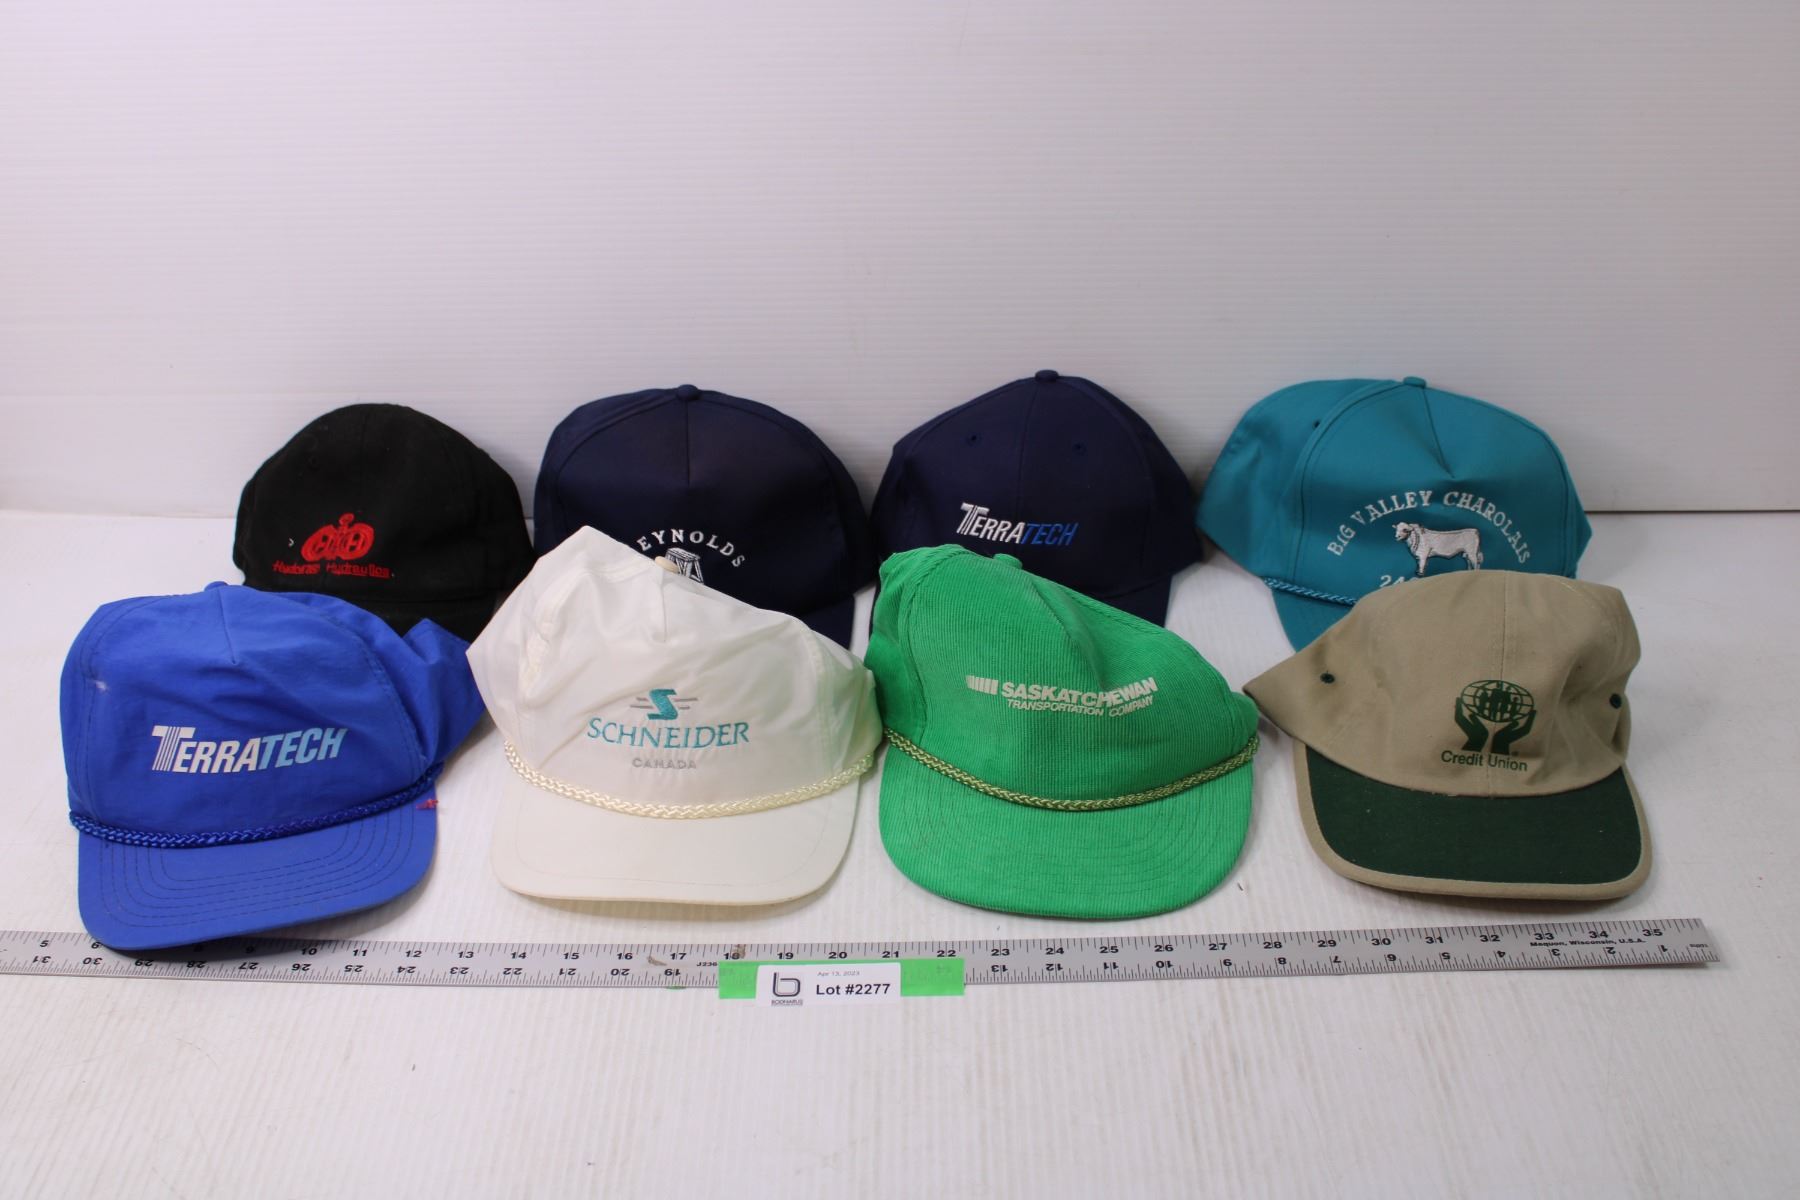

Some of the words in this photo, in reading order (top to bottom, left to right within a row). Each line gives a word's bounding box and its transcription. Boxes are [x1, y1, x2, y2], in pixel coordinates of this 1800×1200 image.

[956, 502, 1079, 546] TERRATECH
[1327, 524, 1356, 556] BIG
[1351, 490, 1433, 526] VALLEY
[1443, 491, 1531, 564] CHAROLAIS
[637, 528, 745, 567] EYNOLDS
[1001, 676, 1159, 708] SASKATCHEWAN
[1007, 699, 1104, 716] TRANSPORTATION
[1109, 695, 1154, 717] COMPANY
[587, 717, 750, 749] SCHNEIDER
[151, 725, 348, 774] TERRATECH
[632, 757, 697, 770] CANADA
[1441, 750, 1484, 767] Credit
[1488, 754, 1528, 771] Union
[40, 939, 49, 948] 5
[301, 948, 317, 956] 10
[353, 949, 367, 957] 11
[405, 950, 422, 958] 12
[458, 951, 474, 959] 13
[563, 952, 580, 960] 15
[670, 952, 687, 960] 17
[723, 952, 740, 960] 18
[777, 952, 794, 960] 19
[828, 951, 848, 959] 20
[882, 951, 899, 959] 21
[936, 950, 956, 958] 22
[1045, 947, 1065, 955] 24
[1100, 946, 1119, 954] 25
[1154, 944, 1174, 952] 26
[1208, 943, 1227, 951] 27
[1263, 941, 1282, 949] 28
[1317, 940, 1337, 948] 29
[1371, 938, 1391, 946] 30
[1425, 936, 1443, 944] 31
[1479, 934, 1500, 942] 32
[1534, 932, 1554, 940] 33
[1588, 930, 1608, 939] 34
[1641, 928, 1663, 936] 35
[32, 955, 51, 964] 31
[83, 957, 102, 965] 30
[134, 958, 153, 966] 29
[238, 961, 258, 970] 27
[292, 963, 311, 971] 26
[344, 964, 364, 973] 25
[397, 966, 416, 974] 24
[450, 966, 469, 975] 23
[503, 967, 522, 975] 22
[559, 968, 576, 976] 21
[610, 968, 630, 976] 20
[664, 968, 681, 976] 19
[991, 965, 1008, 973] 13
[1045, 963, 1063, 971] 12
[1103, 962, 1119, 970] 11
[1155, 960, 1173, 968] 10
[1278, 957, 1287, 965] 8
[1442, 952, 1451, 960] 5
[1497, 950, 1506, 958] 4
[1606, 946, 1616, 955] 2
[816, 984, 841, 996] Lot
[845, 983, 891, 995] #2277
